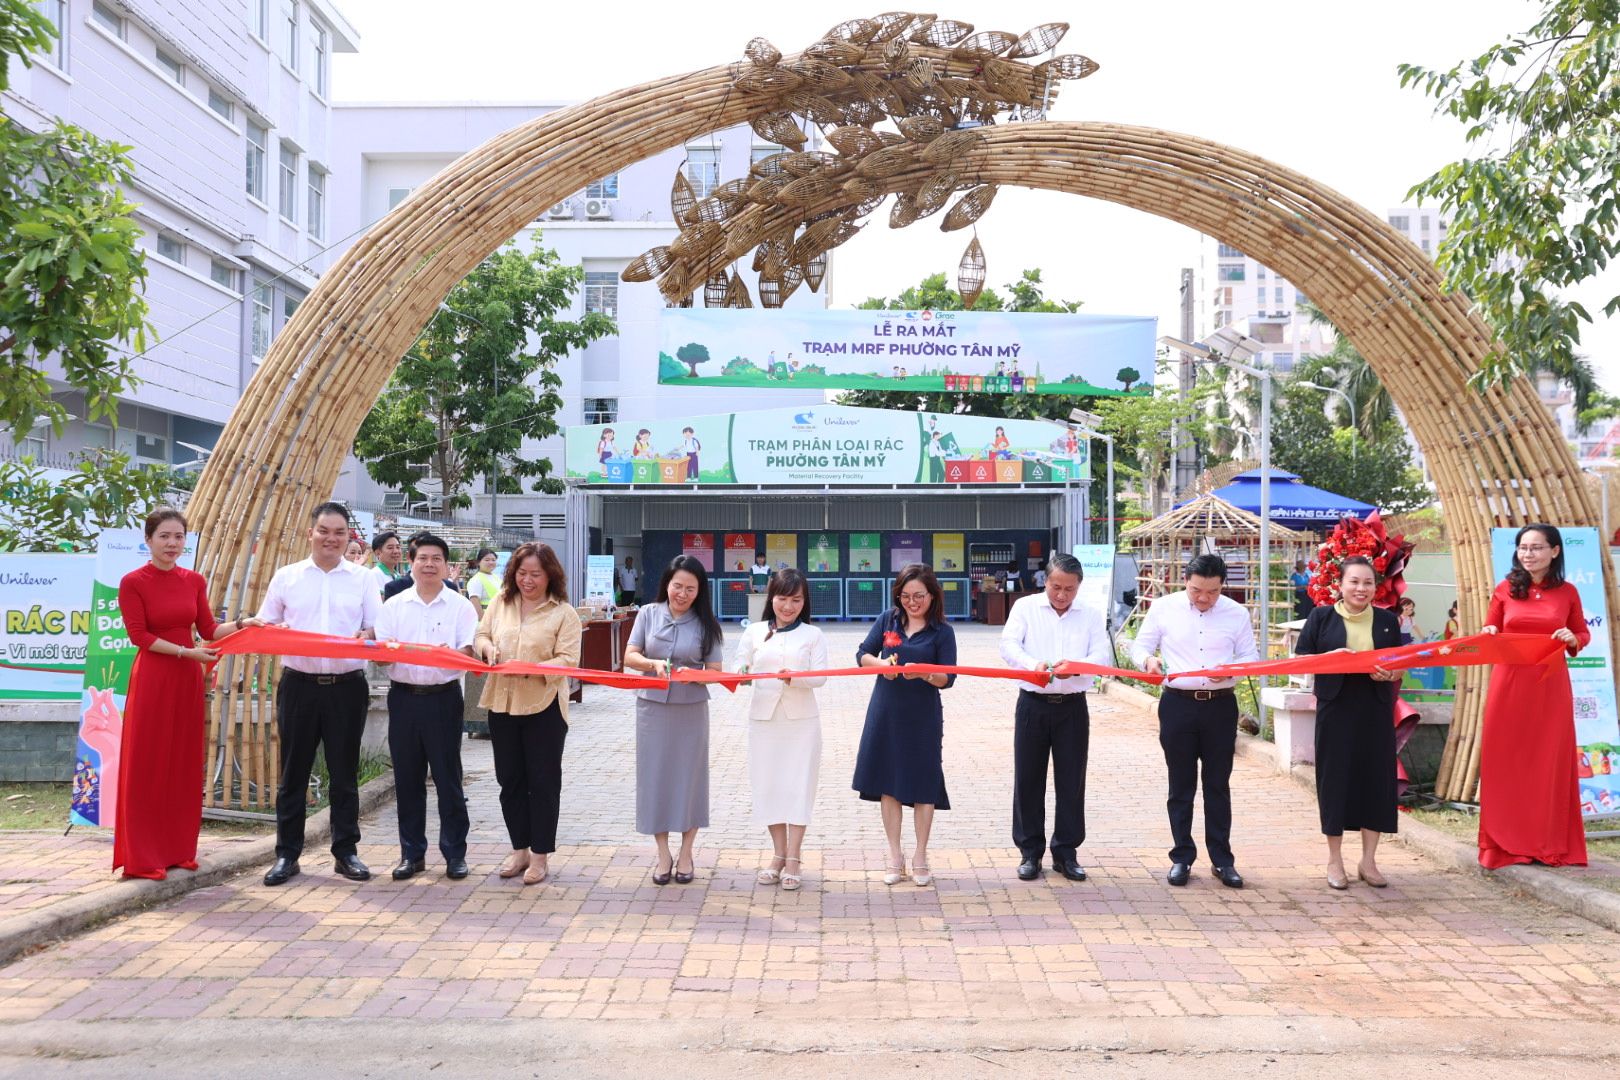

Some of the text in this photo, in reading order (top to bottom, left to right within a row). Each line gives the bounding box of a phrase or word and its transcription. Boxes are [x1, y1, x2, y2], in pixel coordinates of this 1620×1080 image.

[874, 321, 956, 337] LỄ RA MẮT
[802, 341, 1021, 358] TRẠM MRF PHƯỜNG TÂN MỸ
[749, 437, 904, 454] TRẠM PHÂN LOẠI RÁC
[766, 453, 886, 467] PHƯỜNG TÂN MỸ
[0, 572, 57, 586] Unilever
[97, 599, 106, 610] 5
[6, 604, 91, 635] RÁC N
[29, 643, 59, 659] môi
